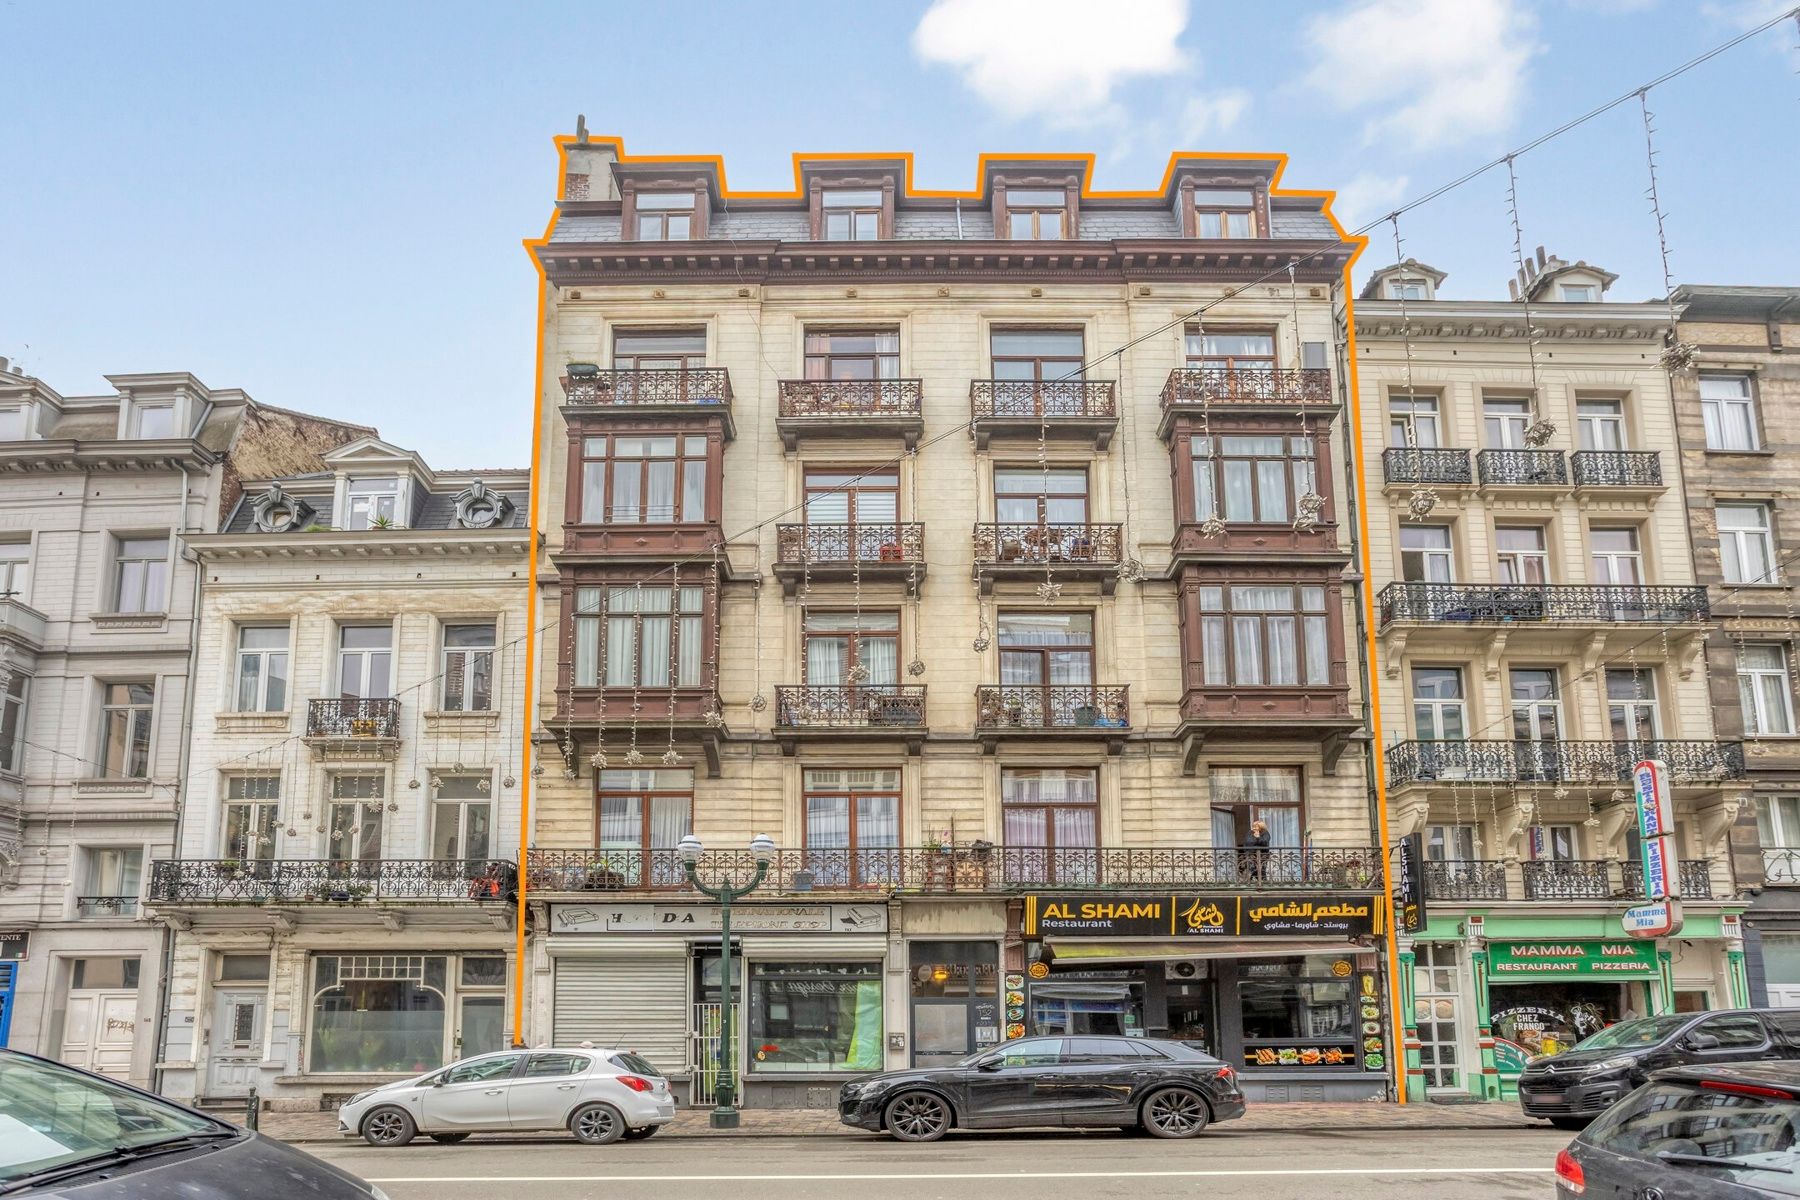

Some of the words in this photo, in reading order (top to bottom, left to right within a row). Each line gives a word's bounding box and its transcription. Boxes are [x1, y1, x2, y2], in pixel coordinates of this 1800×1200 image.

[1639, 772, 1658, 835] RESTARANT
[1648, 842, 1664, 896] PIZZERIA
[711, 908, 825, 916] INERNATIONALE
[1043, 903, 1076, 919] AL
[1081, 903, 1161, 919] SHAMI
[1249, 901, 1312, 922] الشامي
[1313, 902, 1368, 921] مطعم
[1627, 907, 1666, 919] Mamma
[711, 921, 788, 929] TEEPHONE
[1042, 919, 1113, 929] Restaurant
[1636, 918, 1655, 927] Mia
[1510, 945, 1585, 957] MAMMA
[1601, 945, 1635, 956] MIA
[1496, 963, 1578, 971] RESTAURANT
[1592, 962, 1650, 970] PIZZERIA
[1490, 1006, 1566, 1024] PIZZERIA
[1516, 1014, 1539, 1023] CHEZ
[1513, 1022, 1545, 1031] FRANCO
